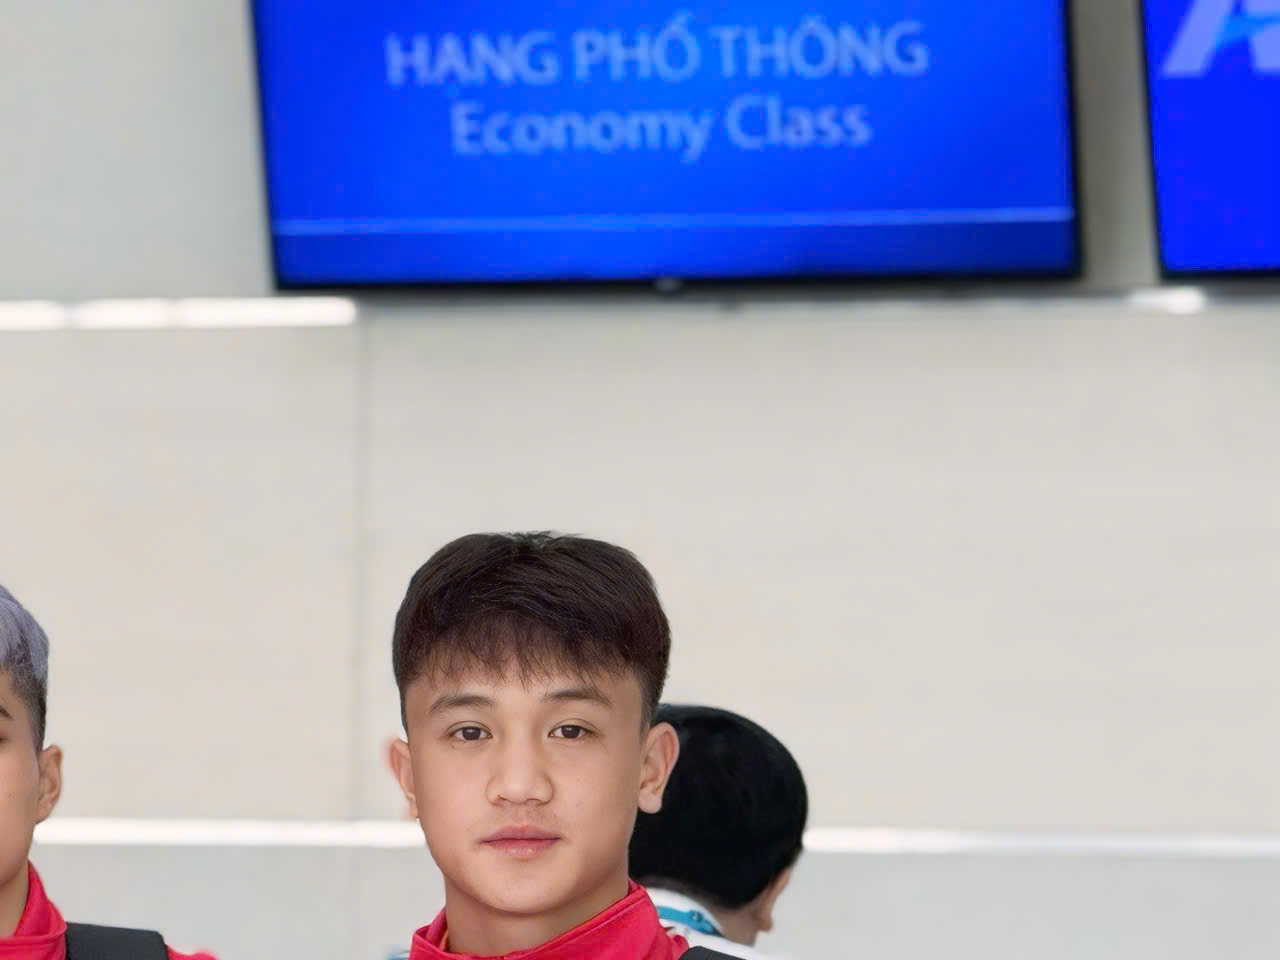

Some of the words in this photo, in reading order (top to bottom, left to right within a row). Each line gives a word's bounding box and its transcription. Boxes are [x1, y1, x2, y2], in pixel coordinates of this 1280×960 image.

[708, 13, 930, 79] THÔNG
[452, 102, 713, 163] Economy
[726, 94, 872, 148] Class
